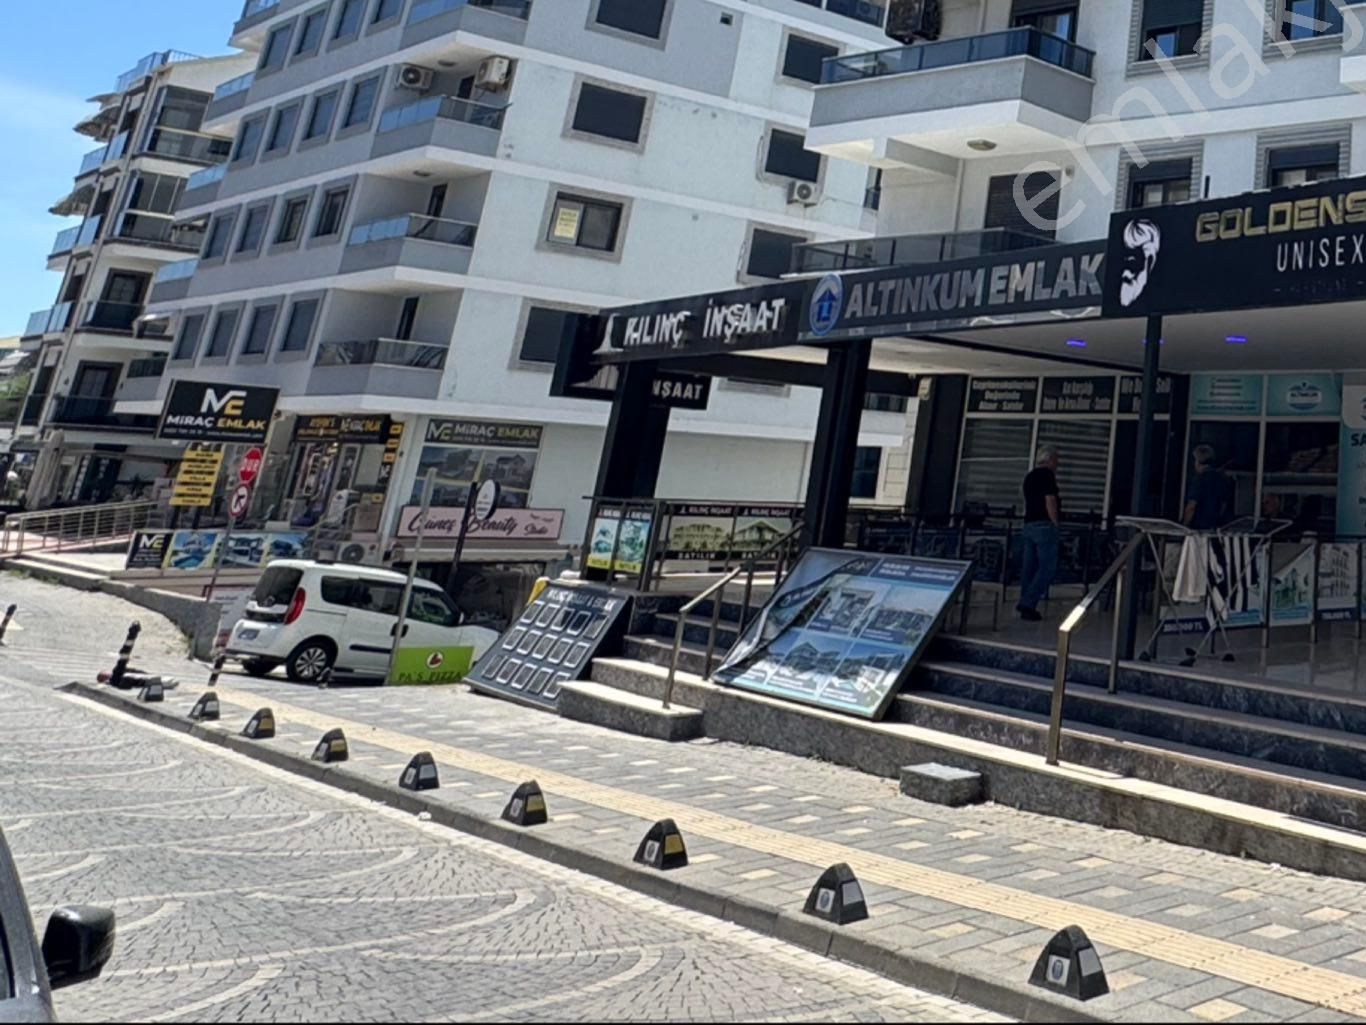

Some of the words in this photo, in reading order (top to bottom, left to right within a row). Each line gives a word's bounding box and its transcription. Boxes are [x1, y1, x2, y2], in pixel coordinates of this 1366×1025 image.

[1277, 234, 1364, 272] UNISEX
[845, 268, 985, 319] ALTINKUM
[988, 253, 1105, 303] EMLAK
[653, 380, 703, 398] NŞAAT
[217, 418, 266, 430] EMLAK
[742, 552, 776, 560] SATIK
